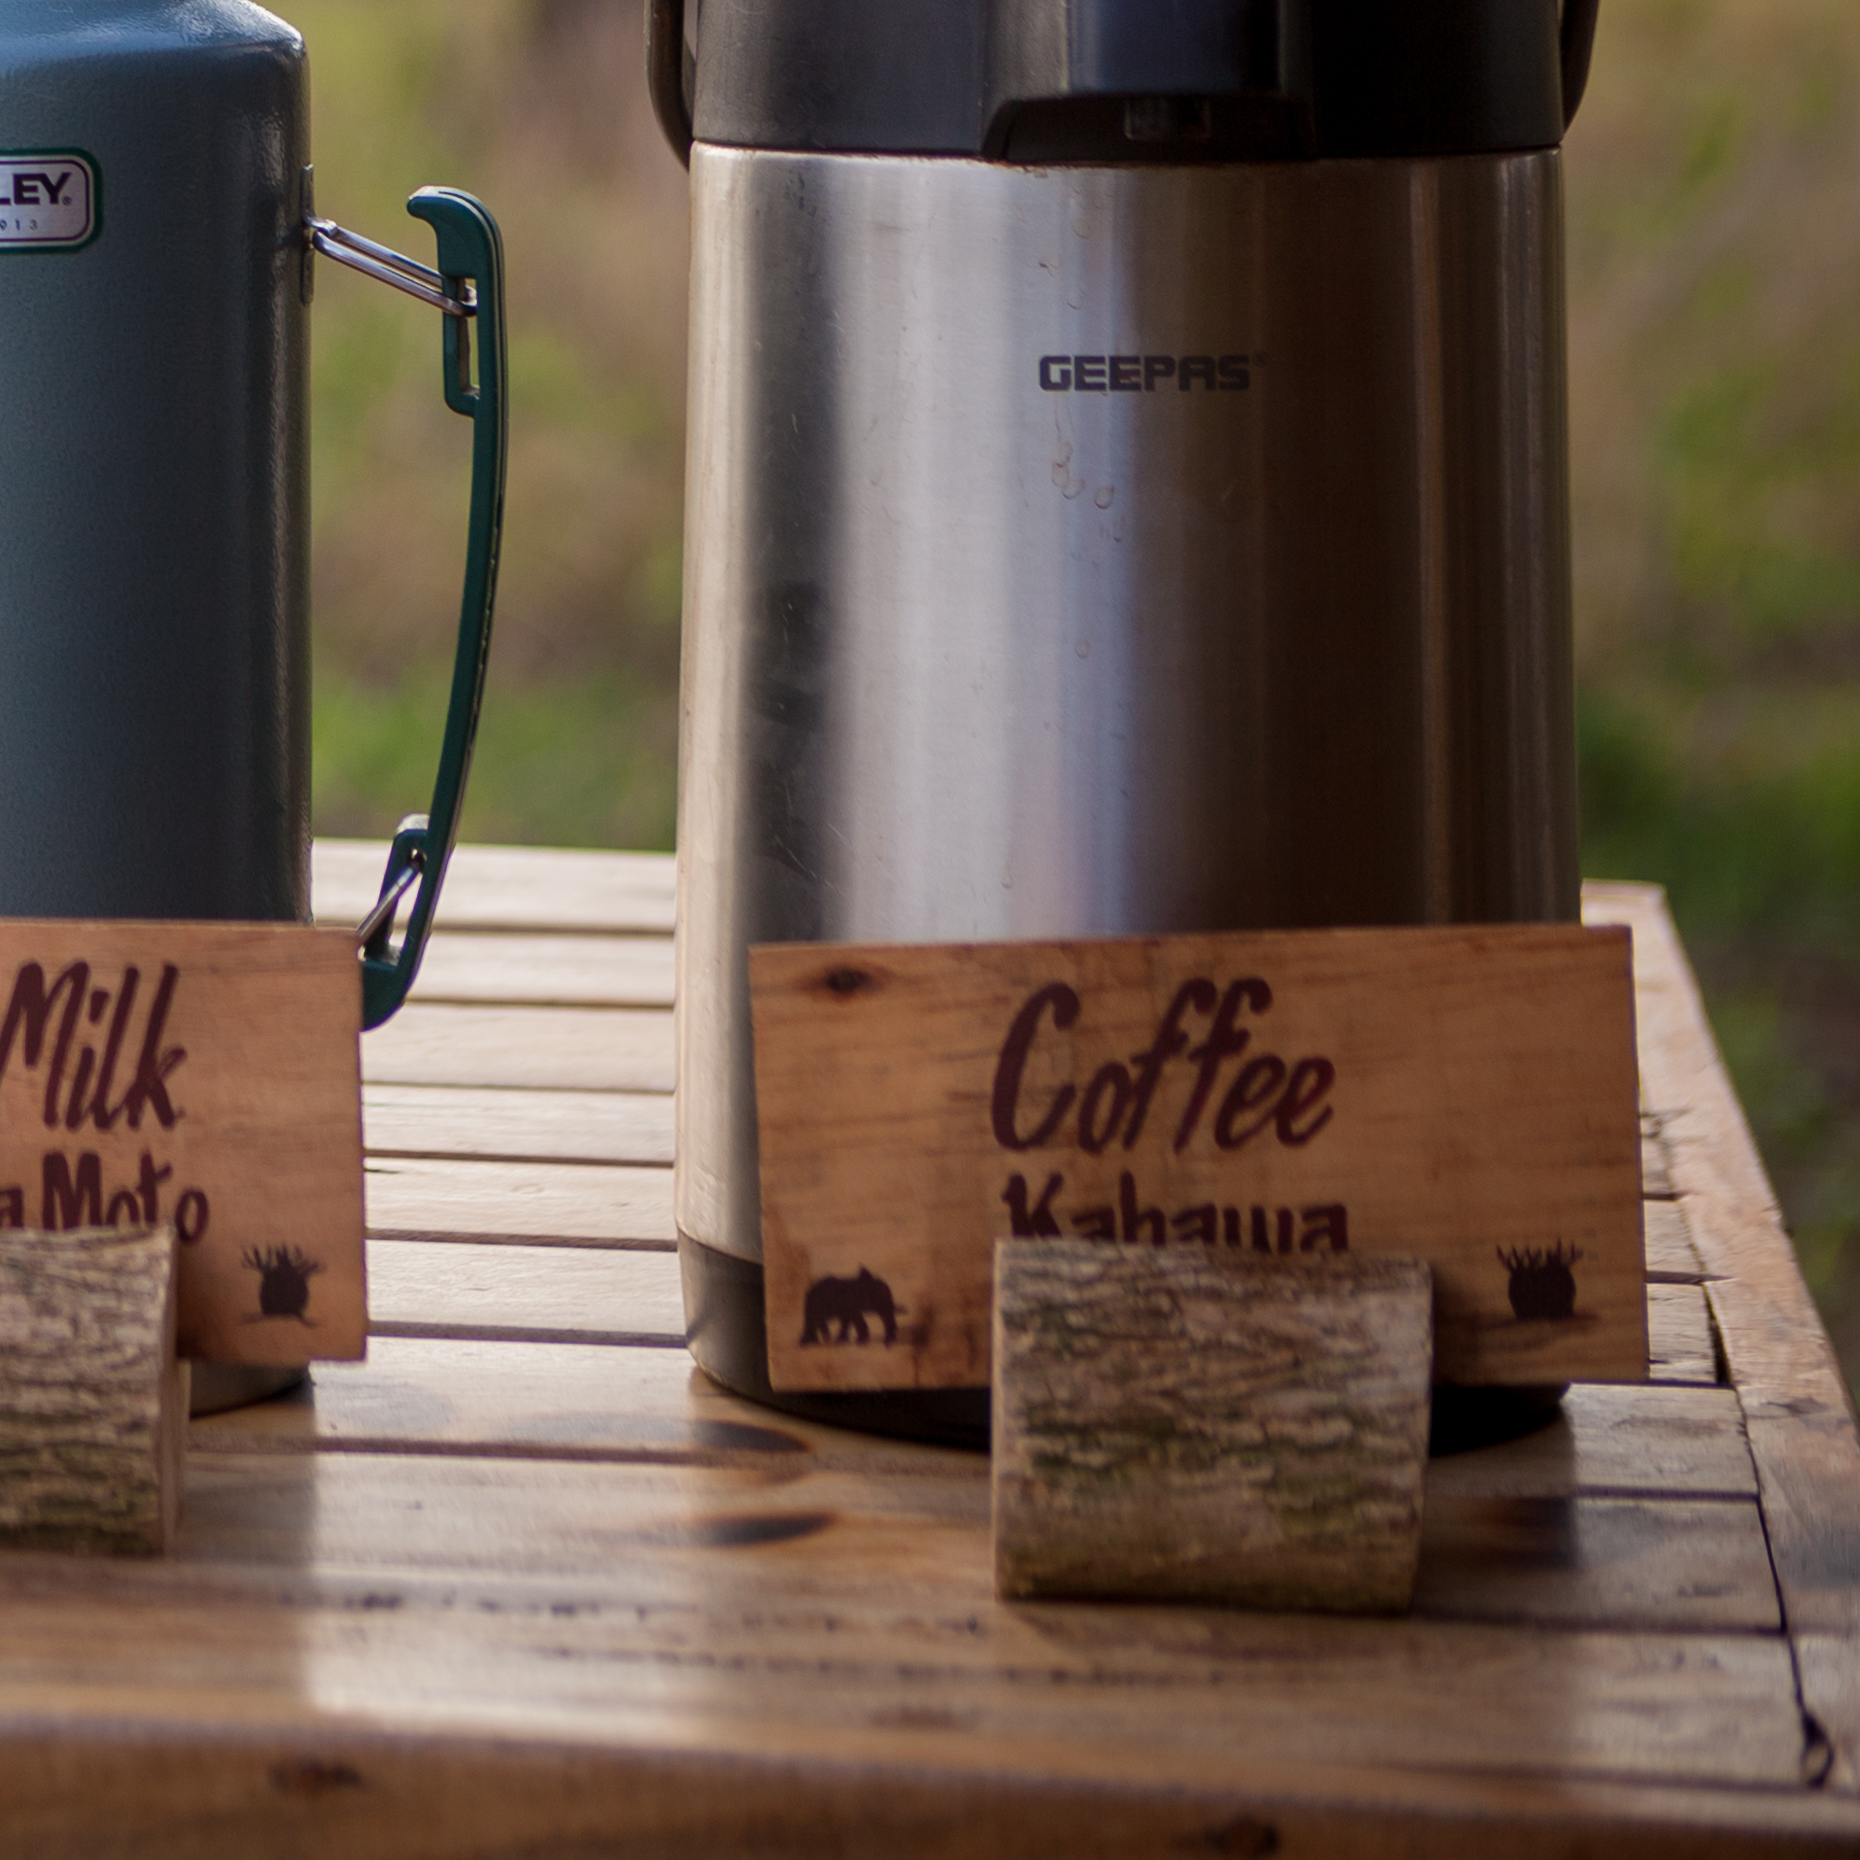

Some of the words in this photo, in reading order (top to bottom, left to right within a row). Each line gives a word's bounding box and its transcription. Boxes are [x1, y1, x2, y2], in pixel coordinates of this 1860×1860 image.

[1039, 355, 1251, 391] GEEPAS
[990, 976, 1337, 1155] Coffee
[41, 1149, 210, 1242] Moto
